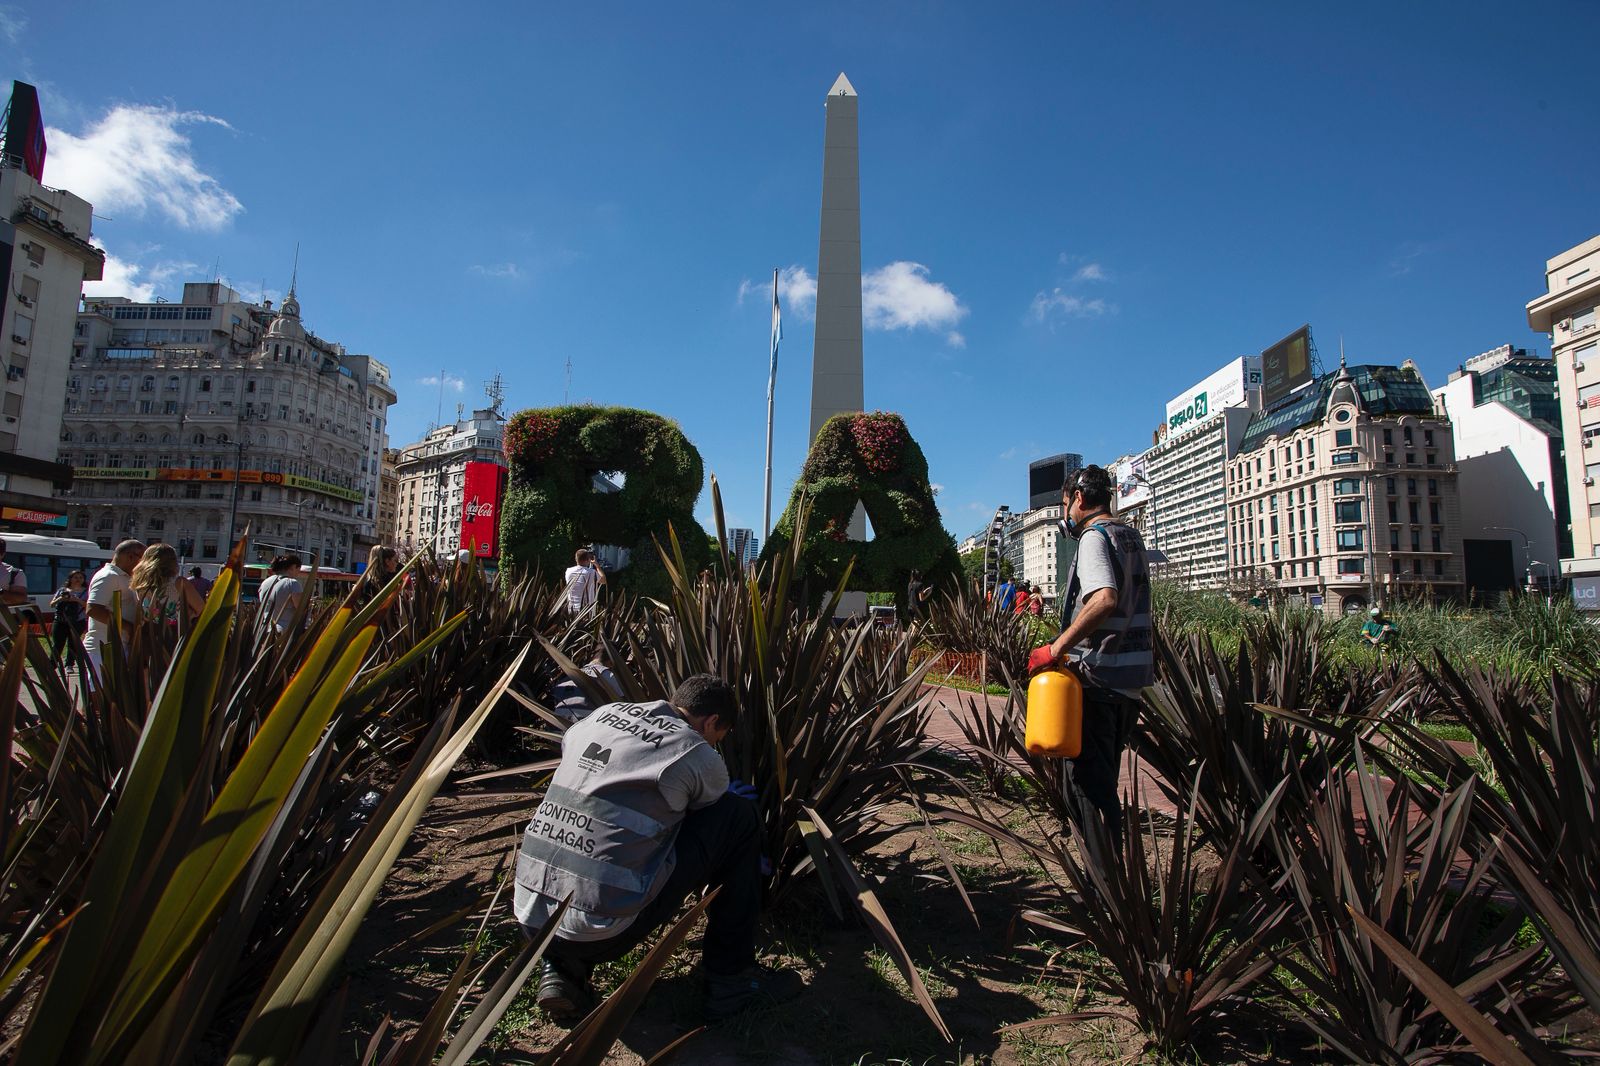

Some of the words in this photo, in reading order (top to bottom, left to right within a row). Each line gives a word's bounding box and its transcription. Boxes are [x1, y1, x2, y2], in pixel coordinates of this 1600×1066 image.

[1169, 405, 1194, 430] SIGLO
[116, 470, 143, 478] MOMENTO
[539, 801, 594, 833] CONTROL
[540, 822, 596, 854] PLAGAS
